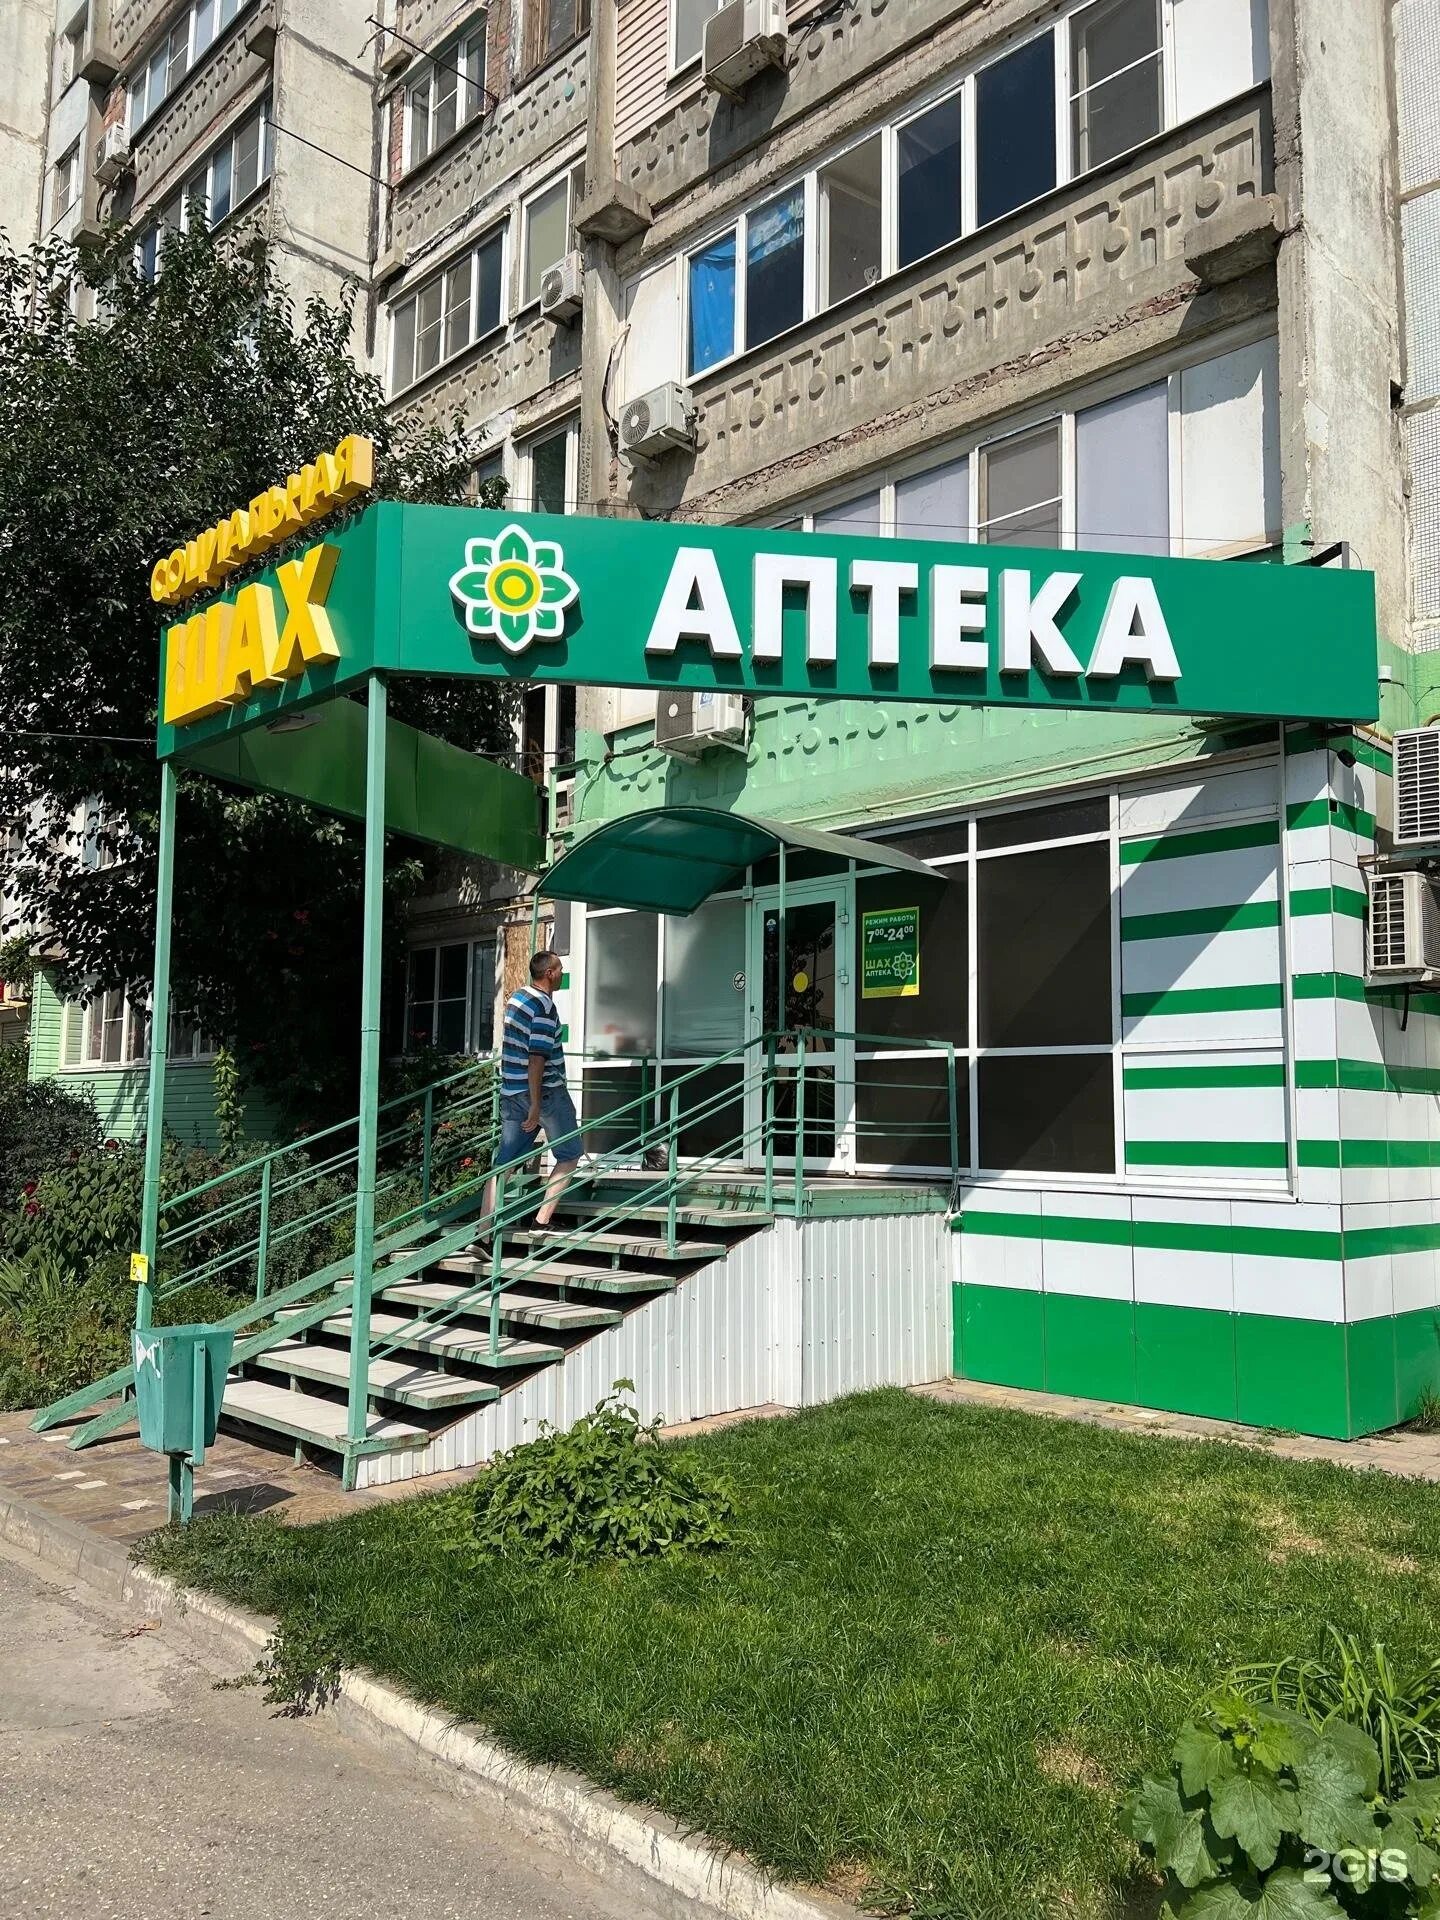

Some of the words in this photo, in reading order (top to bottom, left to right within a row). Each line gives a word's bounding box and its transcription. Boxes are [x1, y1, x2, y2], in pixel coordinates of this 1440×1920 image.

[151, 433, 373, 604] СОЦИАЛЬНАЯ
[164, 543, 341, 726] ШАХ
[644, 546, 1183, 683] АПТЕКА
[890, 914, 915, 923] РАБОТЫ
[866, 958, 891, 969] ШАХ
[866, 969, 891, 977] АПТЕКА
